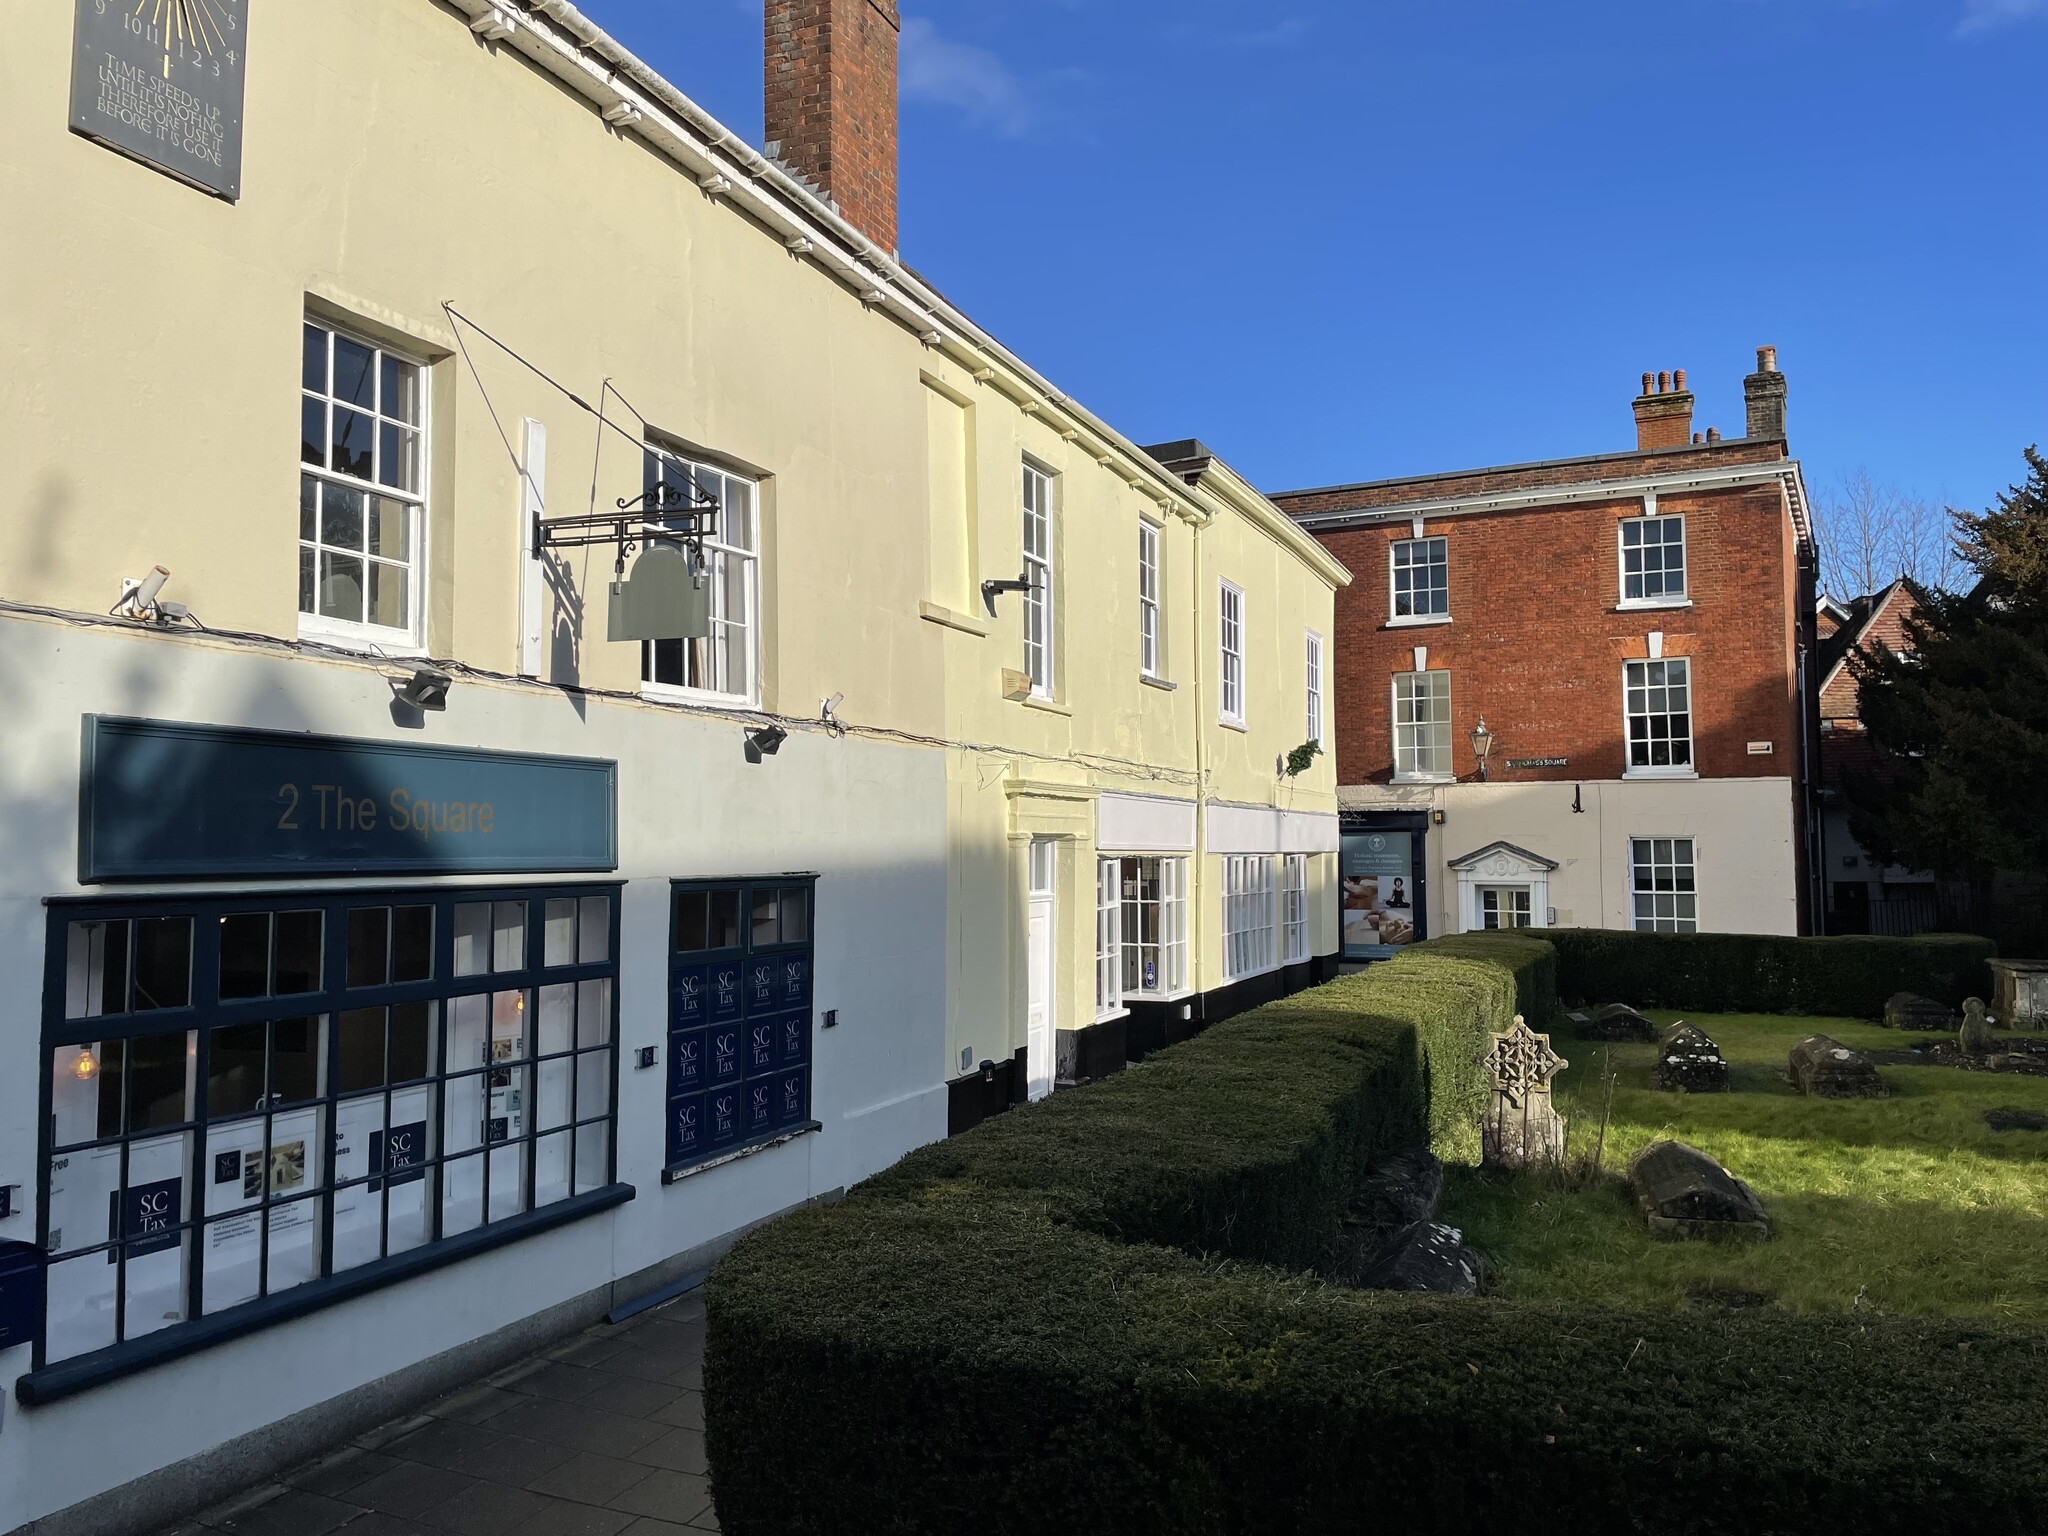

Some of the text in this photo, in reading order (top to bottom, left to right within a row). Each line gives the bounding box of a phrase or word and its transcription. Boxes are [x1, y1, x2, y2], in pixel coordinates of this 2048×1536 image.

[124, 12, 142, 35] 10
[227, 14, 237, 30] 5
[179, 42, 184, 58] 1
[192, 50, 202, 67] 2
[226, 50, 237, 66] 4
[212, 60, 220, 76] 3
[98, 66, 138, 97] UNTIL
[154, 94, 166, 109] IS
[105, 52, 221, 121] TIME SPEEDS UP
[98, 80, 180, 130] THEREFORE
[184, 122, 209, 146] USE
[97, 96, 222, 167] BEFORE IT IS GONE
[277, 784, 494, 842] 2 The Square
[755, 966, 770, 984] SC
[787, 962, 801, 979] SC
[682, 975, 698, 994] SC
[718, 971, 734, 989] SC
[787, 980, 800, 992] Tax
[719, 991, 733, 1004] Tax
[756, 985, 769, 998] Tax
[682, 997, 698, 1011] Tax
[753, 1026, 770, 1047] SC
[786, 1020, 800, 1037] SC
[680, 1040, 697, 1060] SC
[716, 1033, 734, 1055] SC
[786, 1039, 799, 1051] Tax
[717, 1058, 734, 1073] Tax
[753, 1050, 770, 1064] Tax
[680, 1062, 696, 1076] Tax
[785, 1078, 798, 1095] SC
[754, 1086, 768, 1105] SC
[785, 1097, 798, 1110] Tax
[716, 1095, 732, 1115] SC
[754, 1107, 768, 1119] Tax
[679, 1105, 696, 1126] SC
[716, 1118, 731, 1131] Tax
[390, 1132, 411, 1154] SC
[679, 1129, 695, 1142] Tax
[390, 1154, 410, 1168] Tax
[140, 1190, 168, 1216] SC
[140, 1216, 168, 1233] Tax
